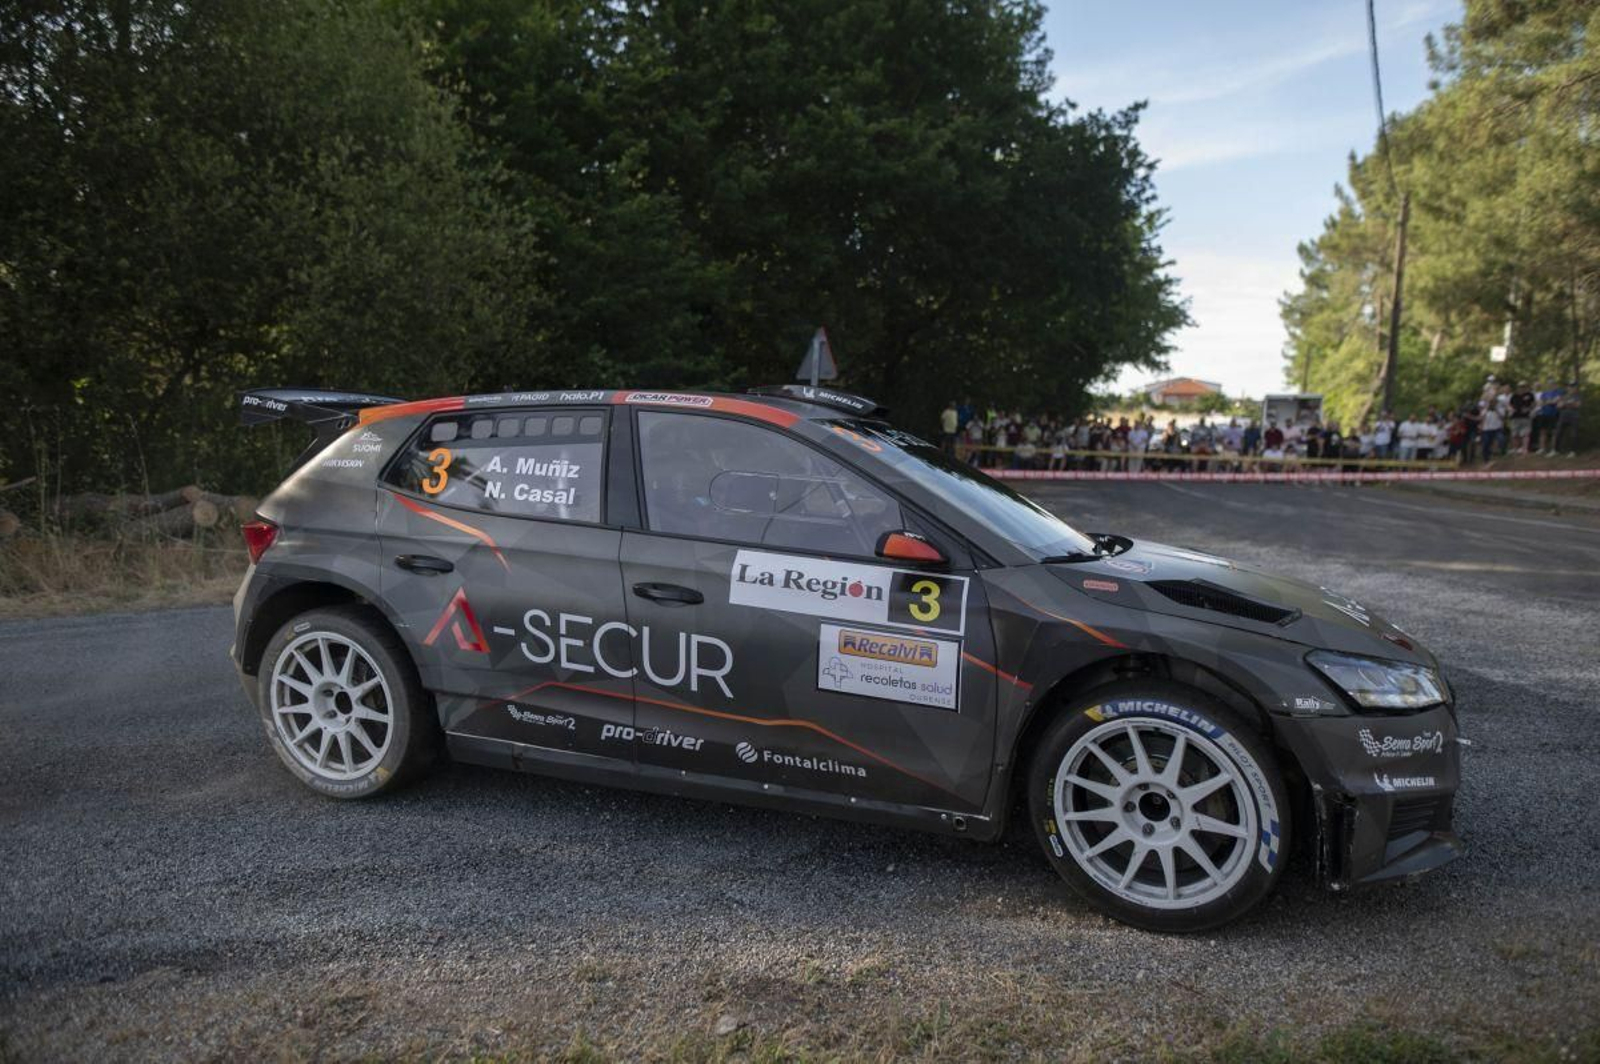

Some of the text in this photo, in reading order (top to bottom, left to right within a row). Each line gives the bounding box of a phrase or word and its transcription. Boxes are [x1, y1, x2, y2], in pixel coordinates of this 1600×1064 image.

[818, 391, 865, 410] MICHELIN
[422, 448, 452, 494] 3
[486, 456, 581, 478] A. Muñiz
[484, 481, 576, 505] N. Casal
[736, 563, 883, 601] La Región
[908, 580, 941, 622] 3
[858, 637, 918, 660] Recalvi
[860, 673, 953, 696] recoletas salud
[1118, 701, 1217, 733] MICHELIN
[601, 723, 704, 752] pro-driver
[763, 750, 867, 778] Fontalclima
[1392, 776, 1436, 788] MICHELIN
